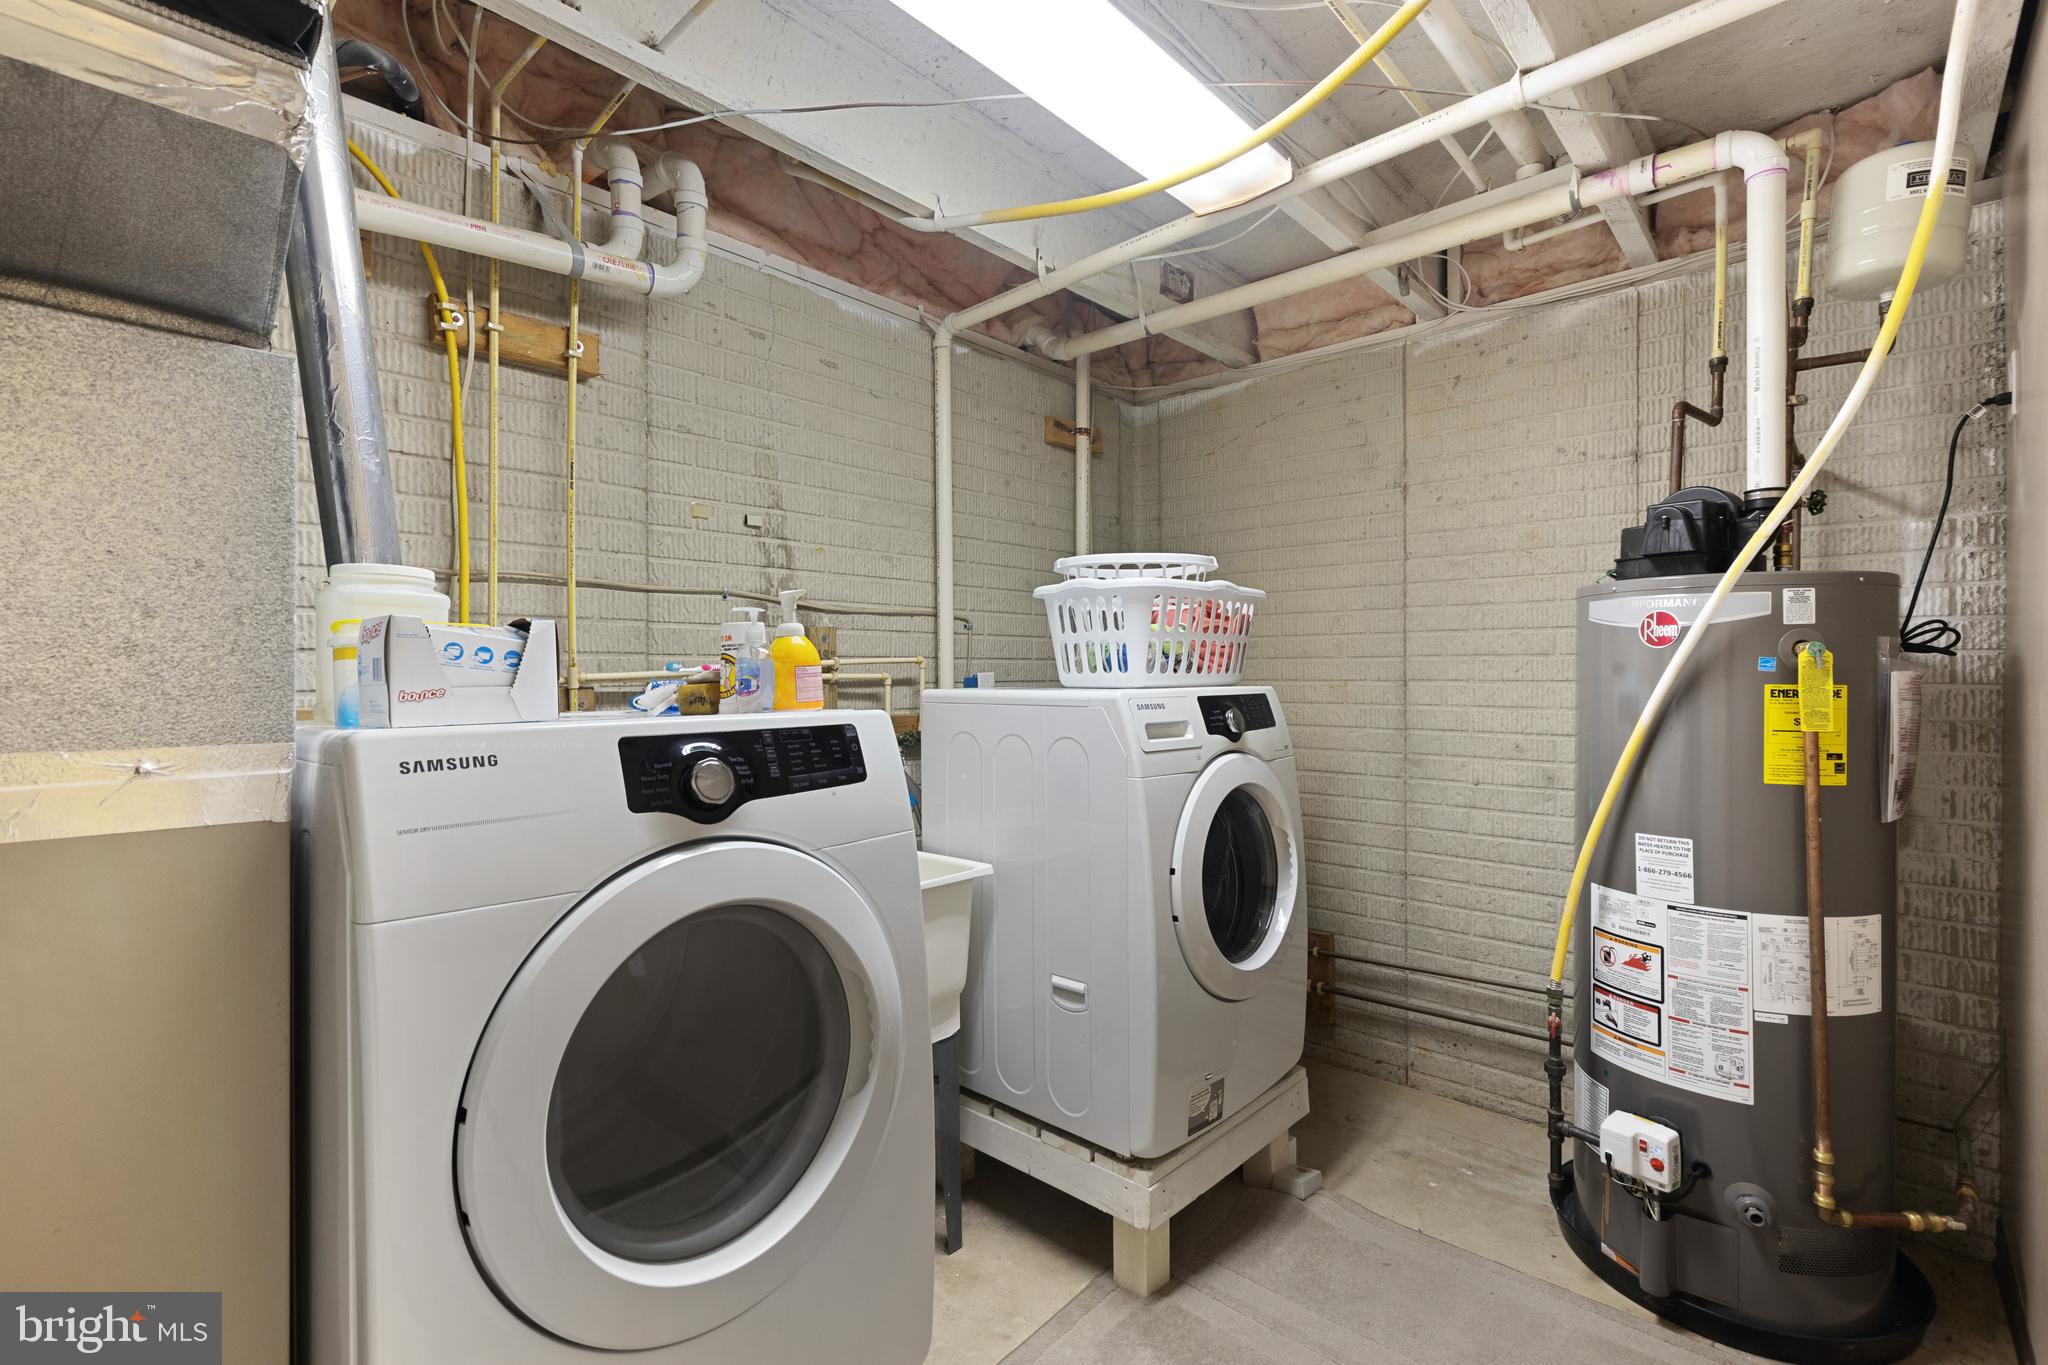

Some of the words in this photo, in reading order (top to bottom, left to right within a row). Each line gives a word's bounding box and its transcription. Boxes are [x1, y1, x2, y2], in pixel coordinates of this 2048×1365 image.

[1644, 611, 1678, 642] Rheem
[398, 688, 446, 703] bounce
[1136, 703, 1166, 711] SAMSUNG
[399, 754, 498, 775] SAMSUNG
[1661, 850, 1689, 858] PURCHASE
